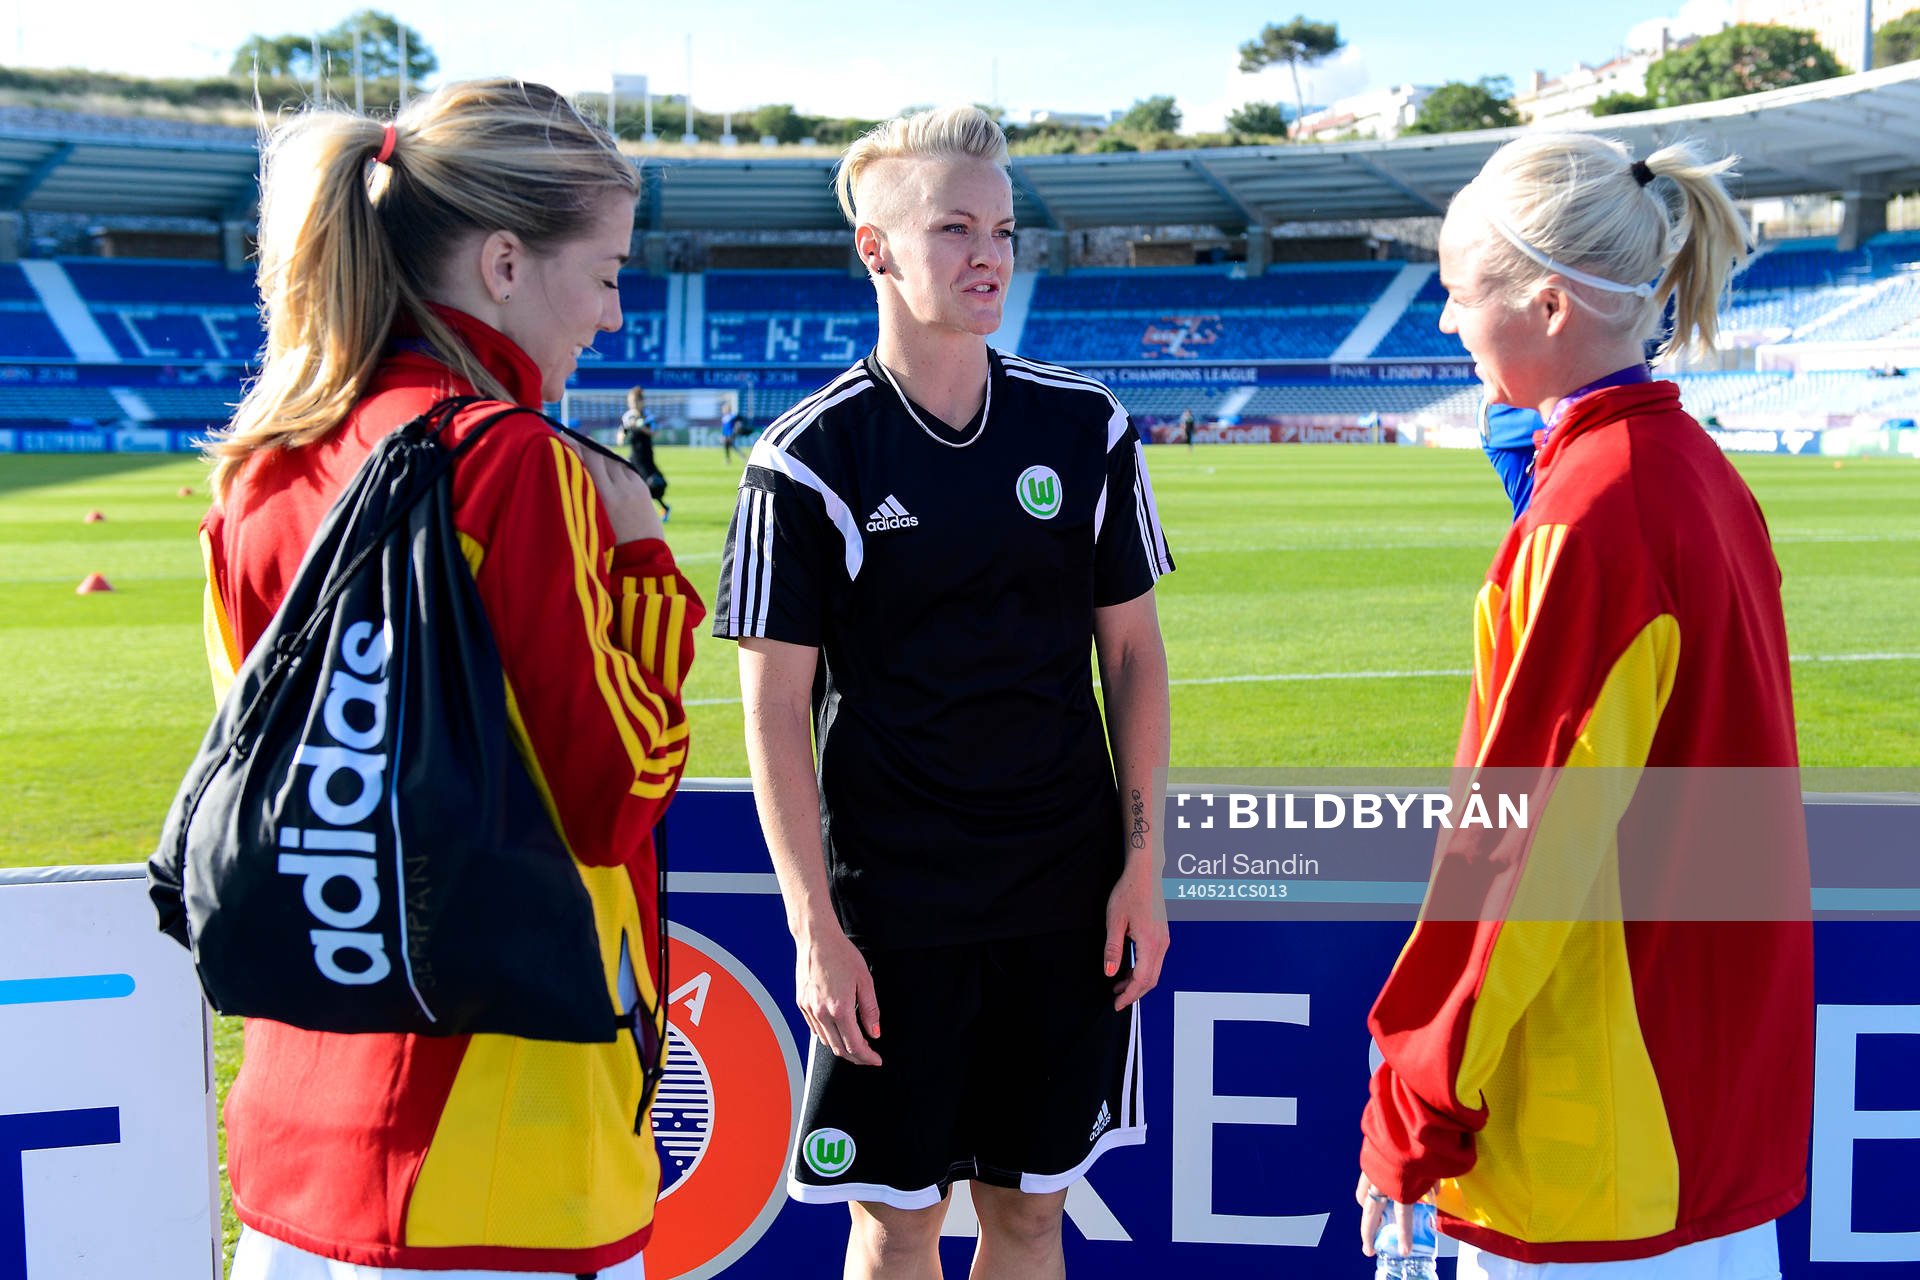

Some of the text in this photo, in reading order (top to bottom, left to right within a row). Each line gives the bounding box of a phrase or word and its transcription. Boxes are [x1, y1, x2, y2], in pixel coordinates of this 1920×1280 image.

[1119, 368, 1201, 382] CHAMPIONS
[1204, 367, 1257, 382] LEAGUE
[1330, 364, 1371, 379] FINAL
[1378, 365, 1432, 380] LISBON
[866, 515, 919, 532] adidas
[278, 620, 394, 986] adidas
